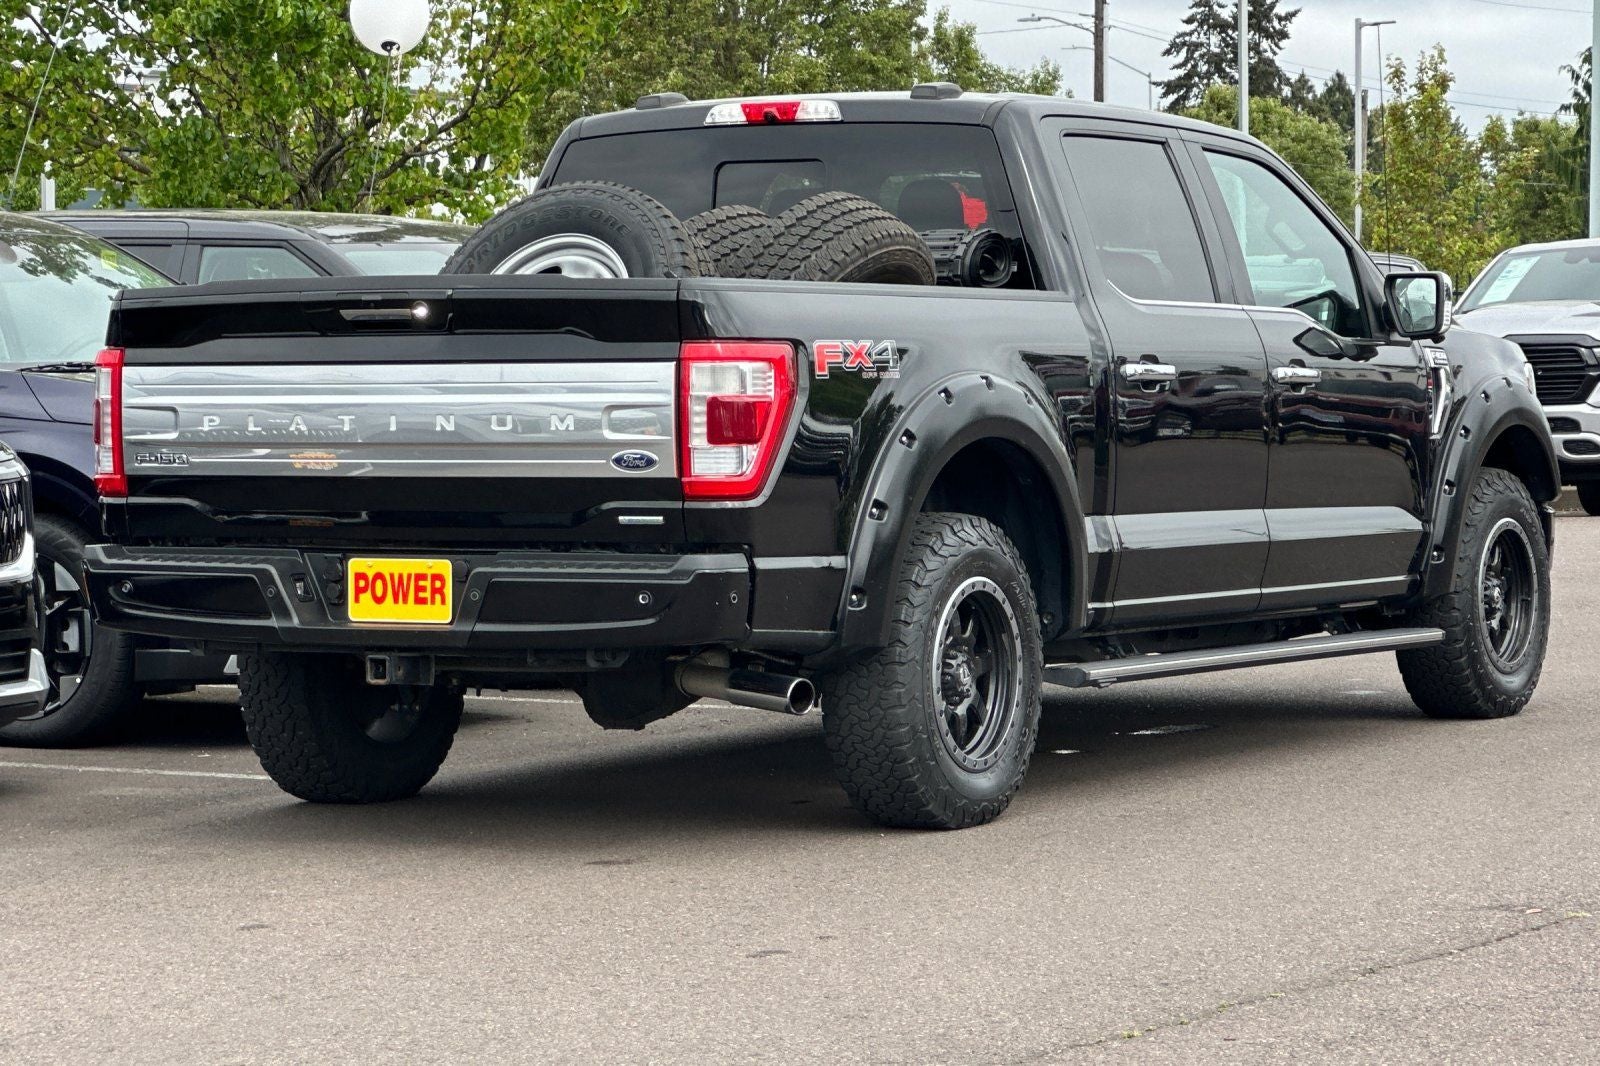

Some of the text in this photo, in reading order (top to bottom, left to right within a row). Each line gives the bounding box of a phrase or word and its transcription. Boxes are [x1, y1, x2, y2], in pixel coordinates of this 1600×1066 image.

[813, 340, 900, 378] FX4
[203, 414, 575, 432] PLATINUM
[134, 452, 190, 466] F-150
[621, 453, 648, 468] Ford
[354, 571, 446, 606] POWER
